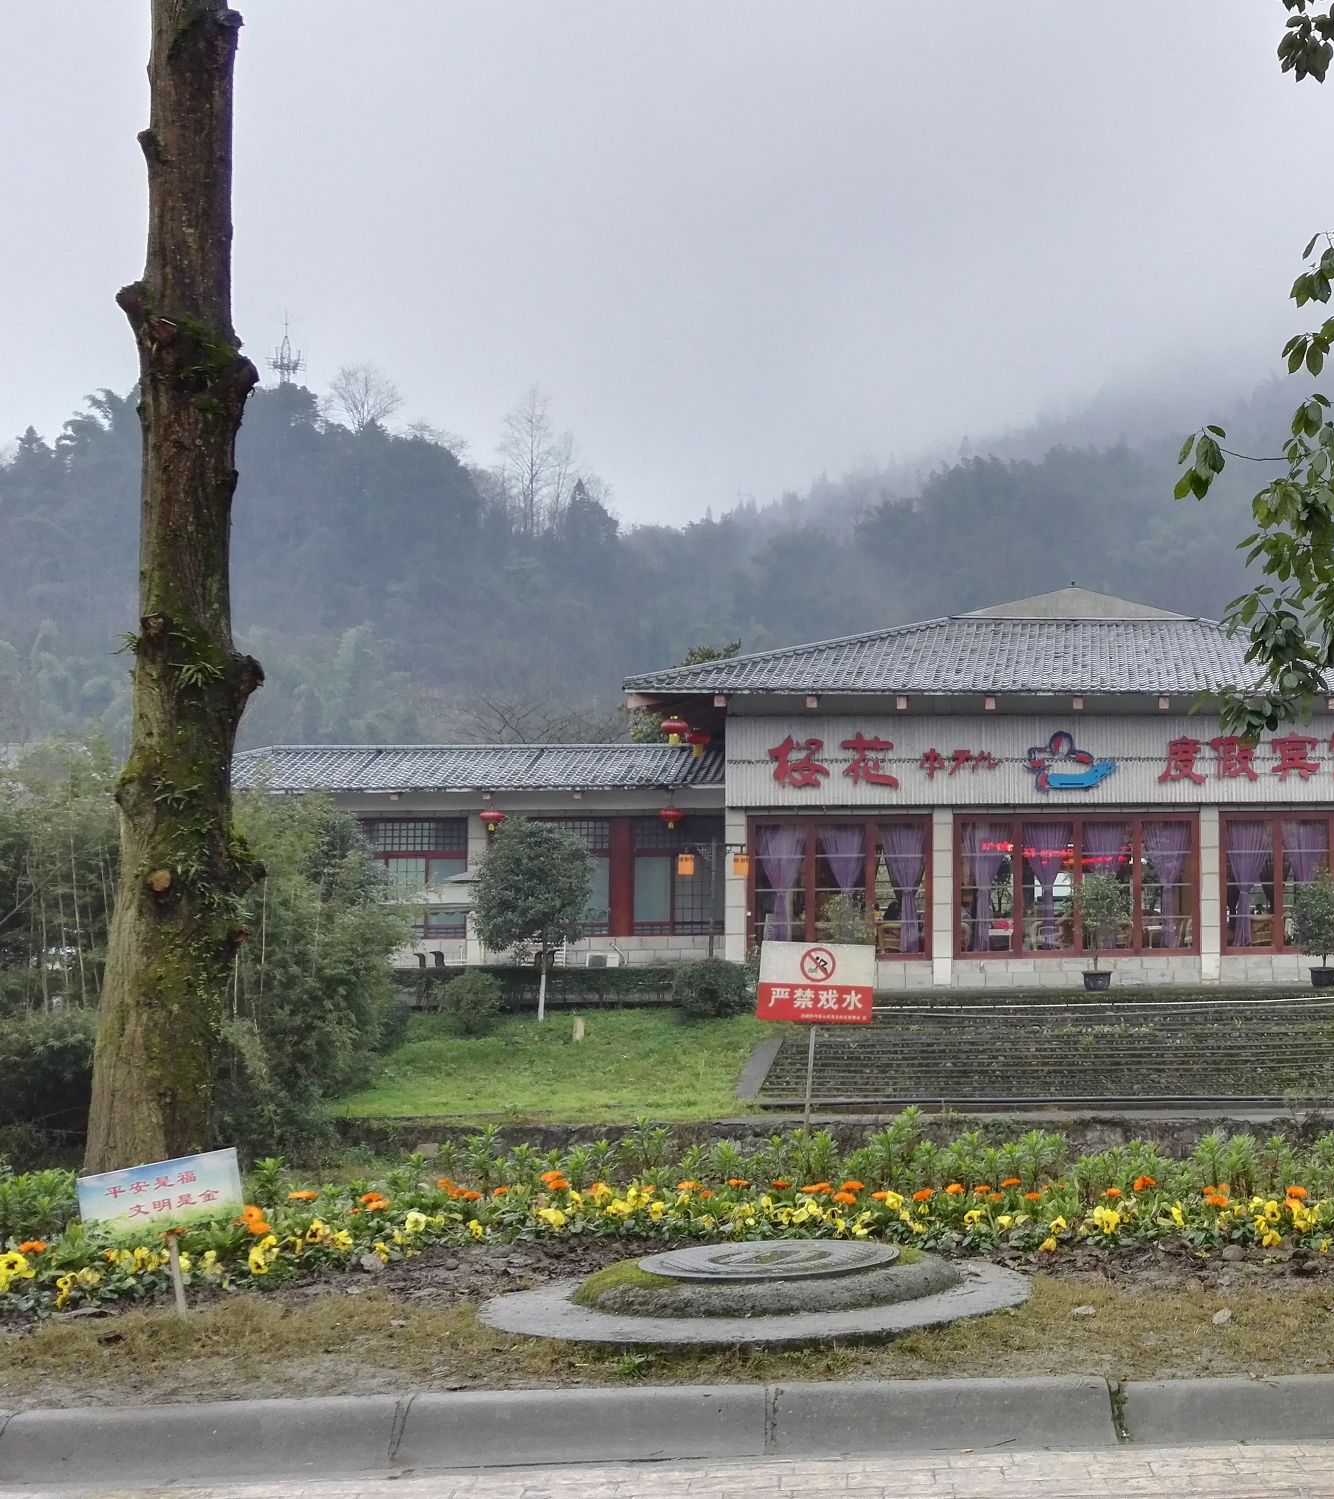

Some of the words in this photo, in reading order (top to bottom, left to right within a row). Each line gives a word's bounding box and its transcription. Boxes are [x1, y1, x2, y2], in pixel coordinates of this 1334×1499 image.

[768, 987, 863, 1011] 严禁戏水
[104, 1170, 198, 1199] 平安是福
[128, 1189, 220, 1219] 文明是金
